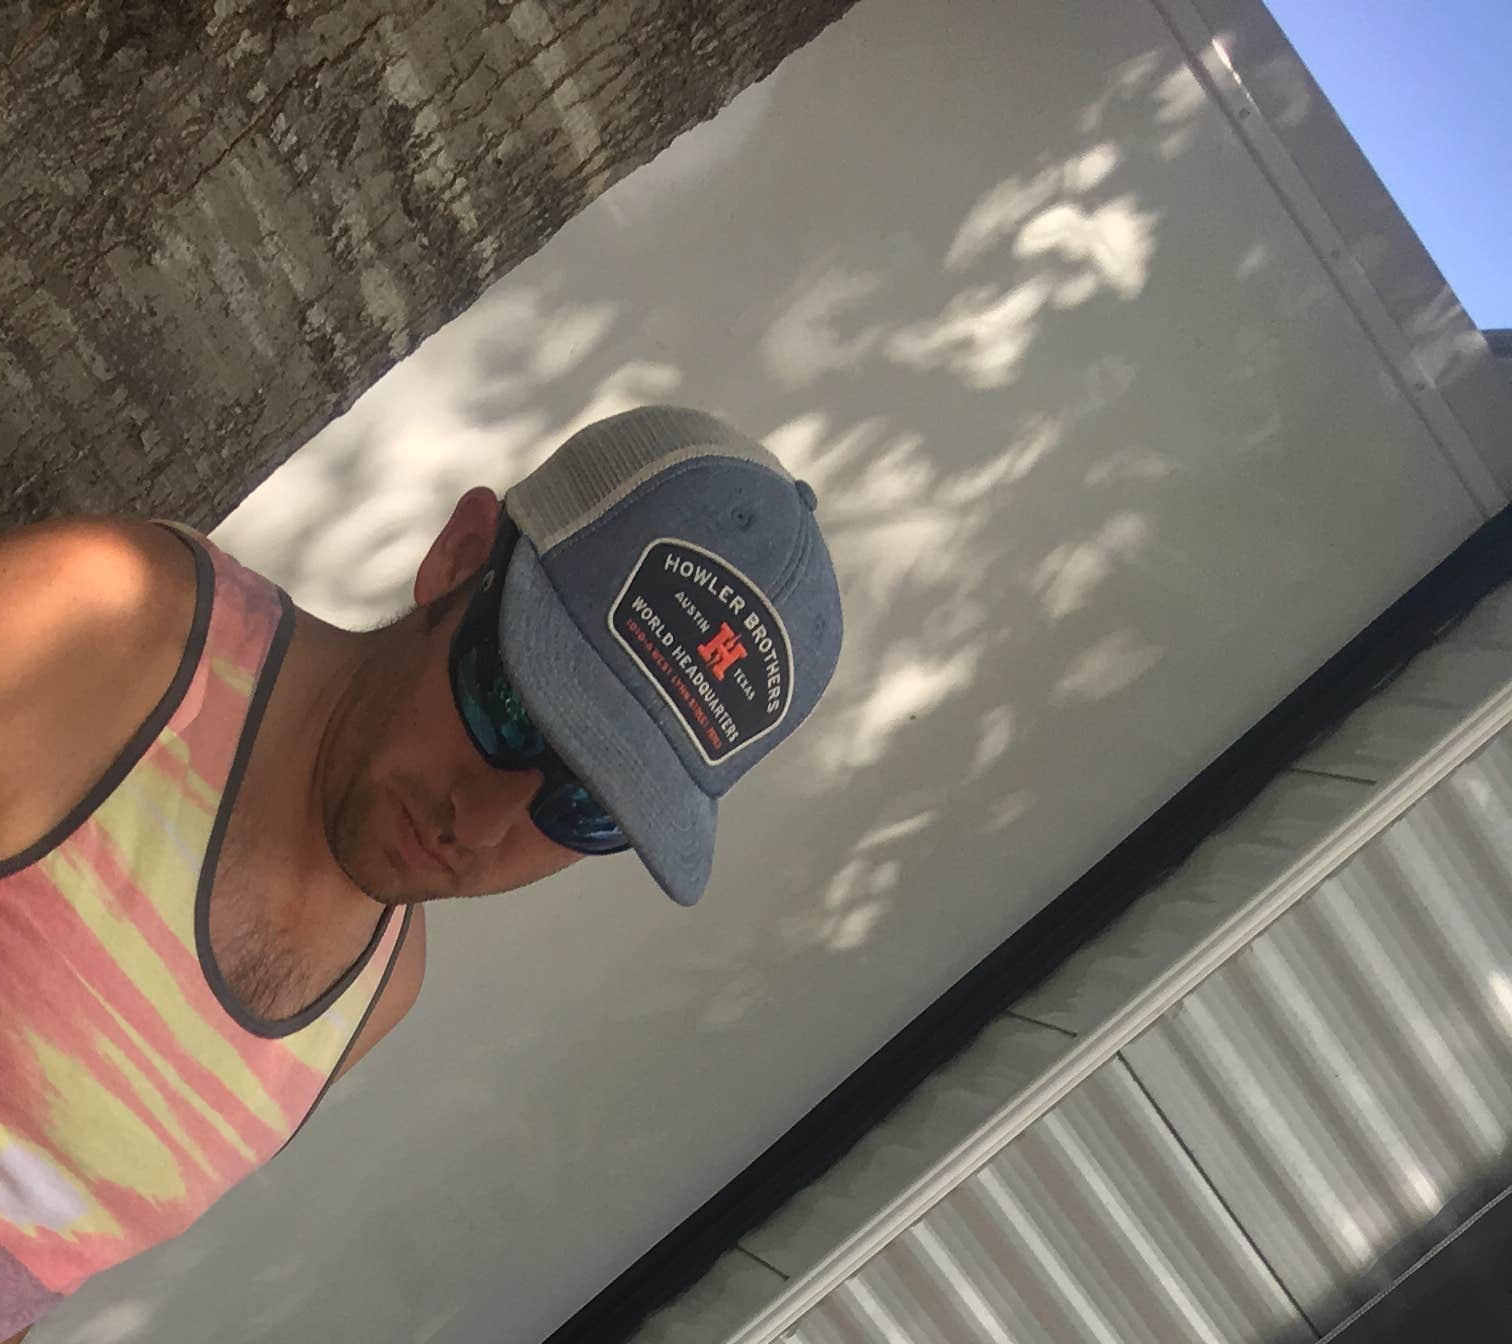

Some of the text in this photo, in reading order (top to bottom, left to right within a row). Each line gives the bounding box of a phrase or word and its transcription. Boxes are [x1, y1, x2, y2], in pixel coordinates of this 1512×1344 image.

[664, 553, 781, 714] HOWLER BROTHERS
[674, 590, 711, 633] AUSTIN
[631, 595, 739, 743] WORLD HEADQUARTERS
[733, 668, 756, 701] TEXAS
